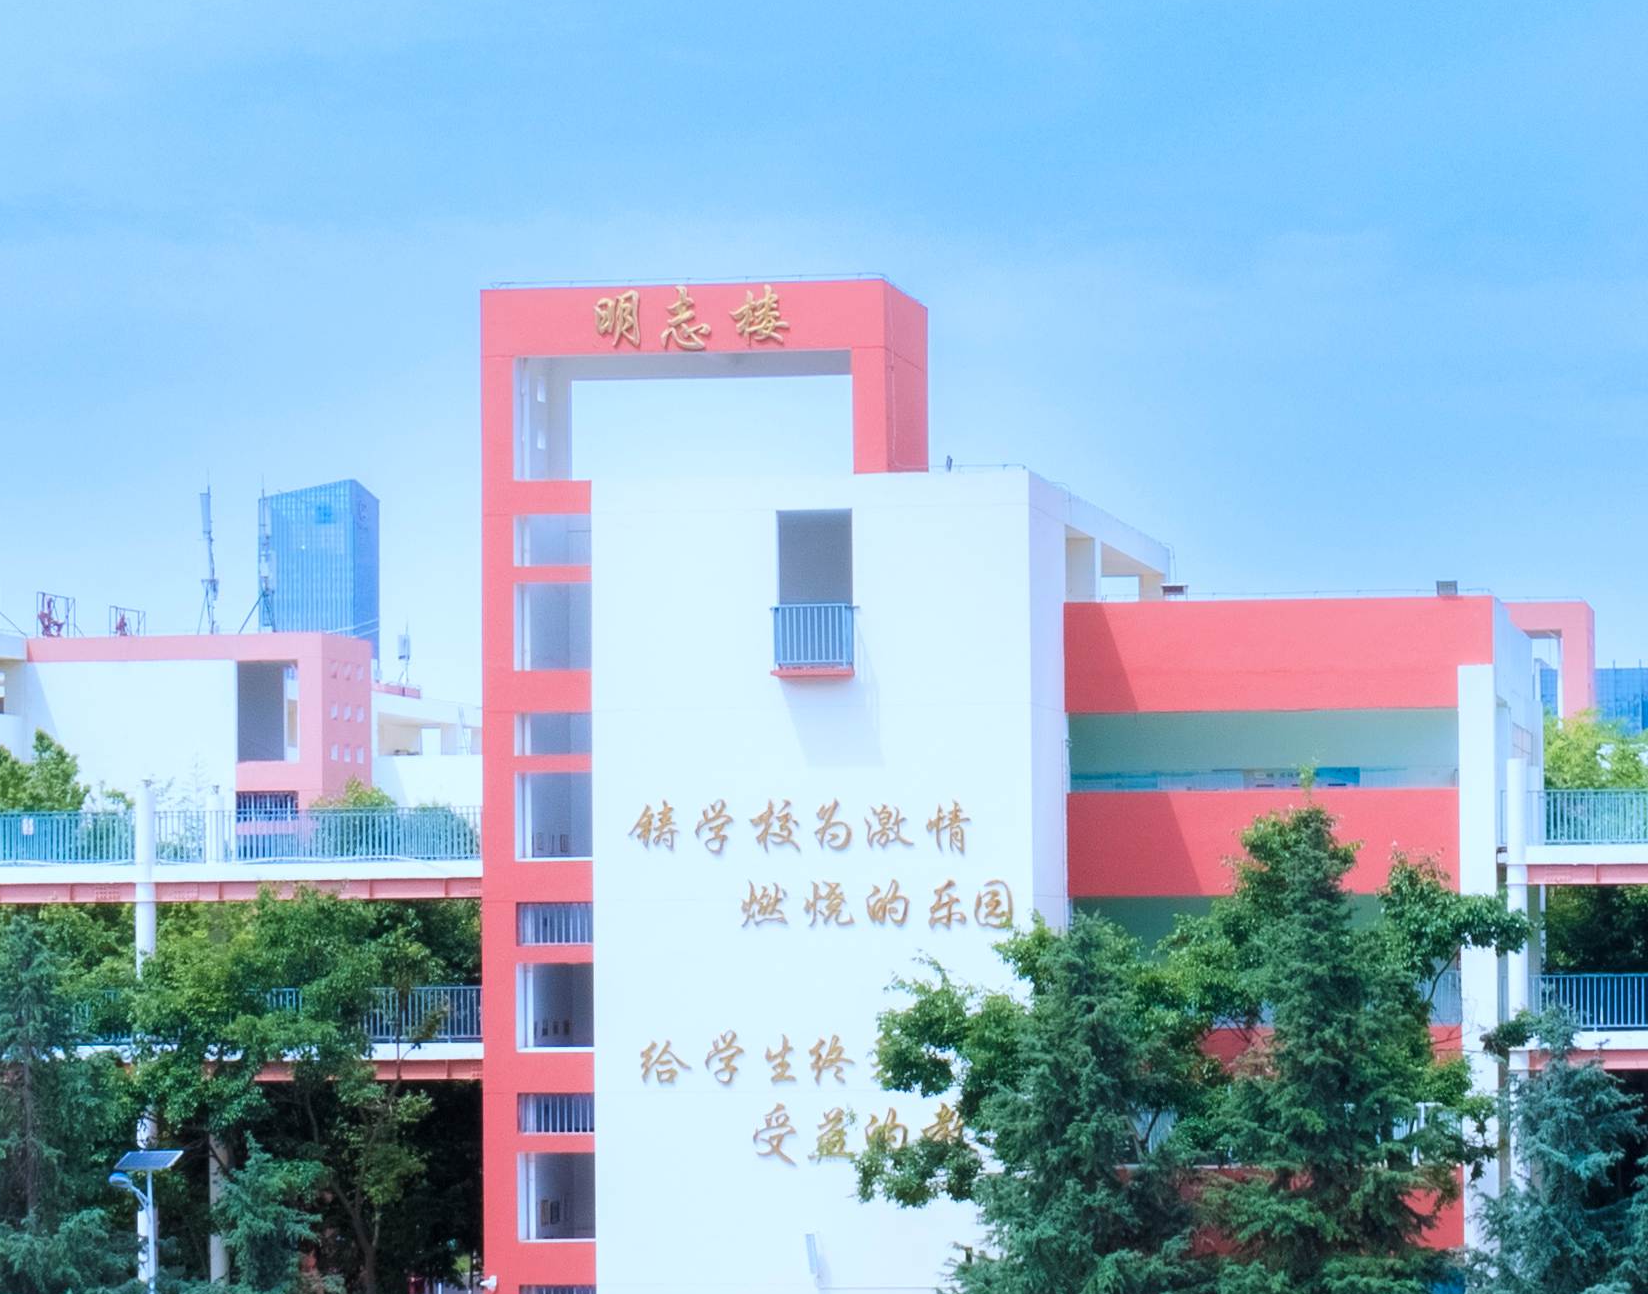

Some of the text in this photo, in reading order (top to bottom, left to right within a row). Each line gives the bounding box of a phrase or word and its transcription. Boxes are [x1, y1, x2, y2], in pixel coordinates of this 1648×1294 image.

[593, 284, 791, 352] 明志楼
[628, 798, 972, 855] 铸学校为激情
[739, 878, 1015, 931] 燃烧的乐园
[640, 1030, 880, 1086] 给学生终
